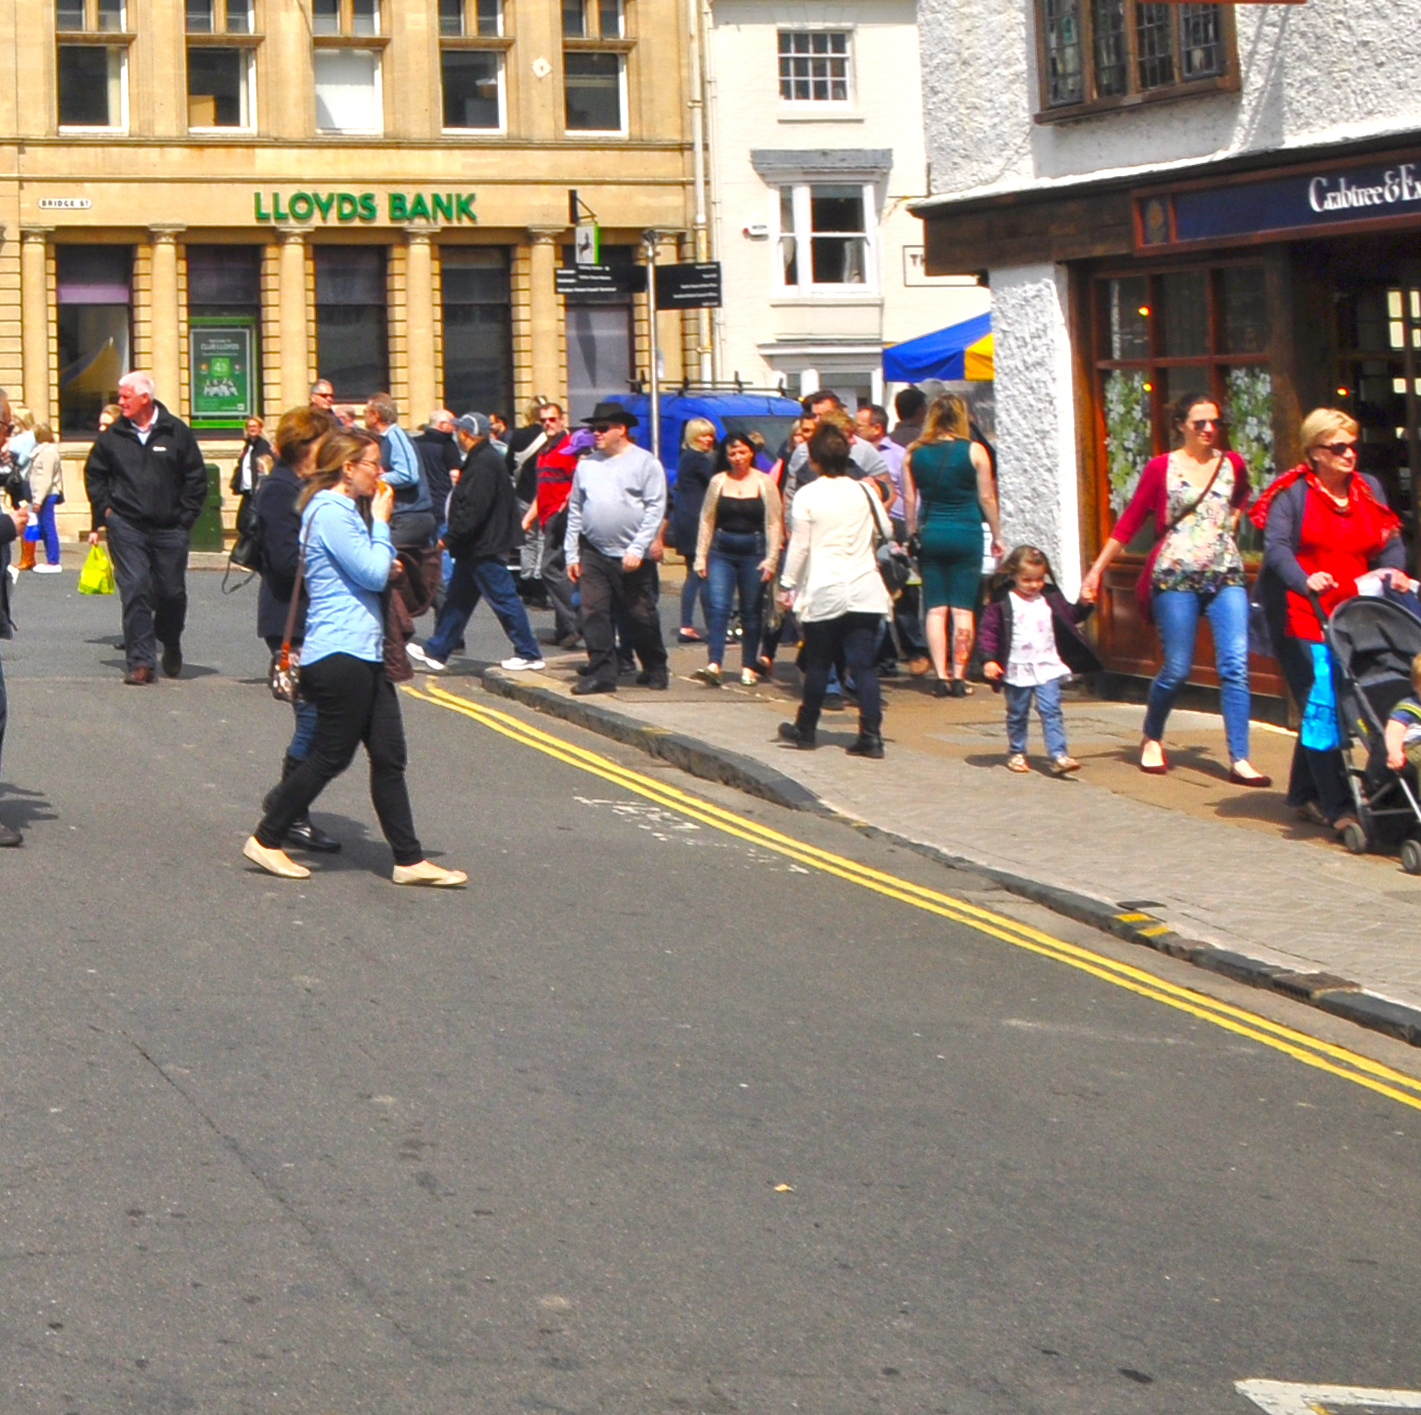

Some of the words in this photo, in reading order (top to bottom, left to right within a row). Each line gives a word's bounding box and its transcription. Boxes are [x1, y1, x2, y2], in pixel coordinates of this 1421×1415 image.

[254, 191, 377, 221] LLOYDS
[387, 192, 478, 221] BANK
[1309, 176, 1384, 213] Crabtree
